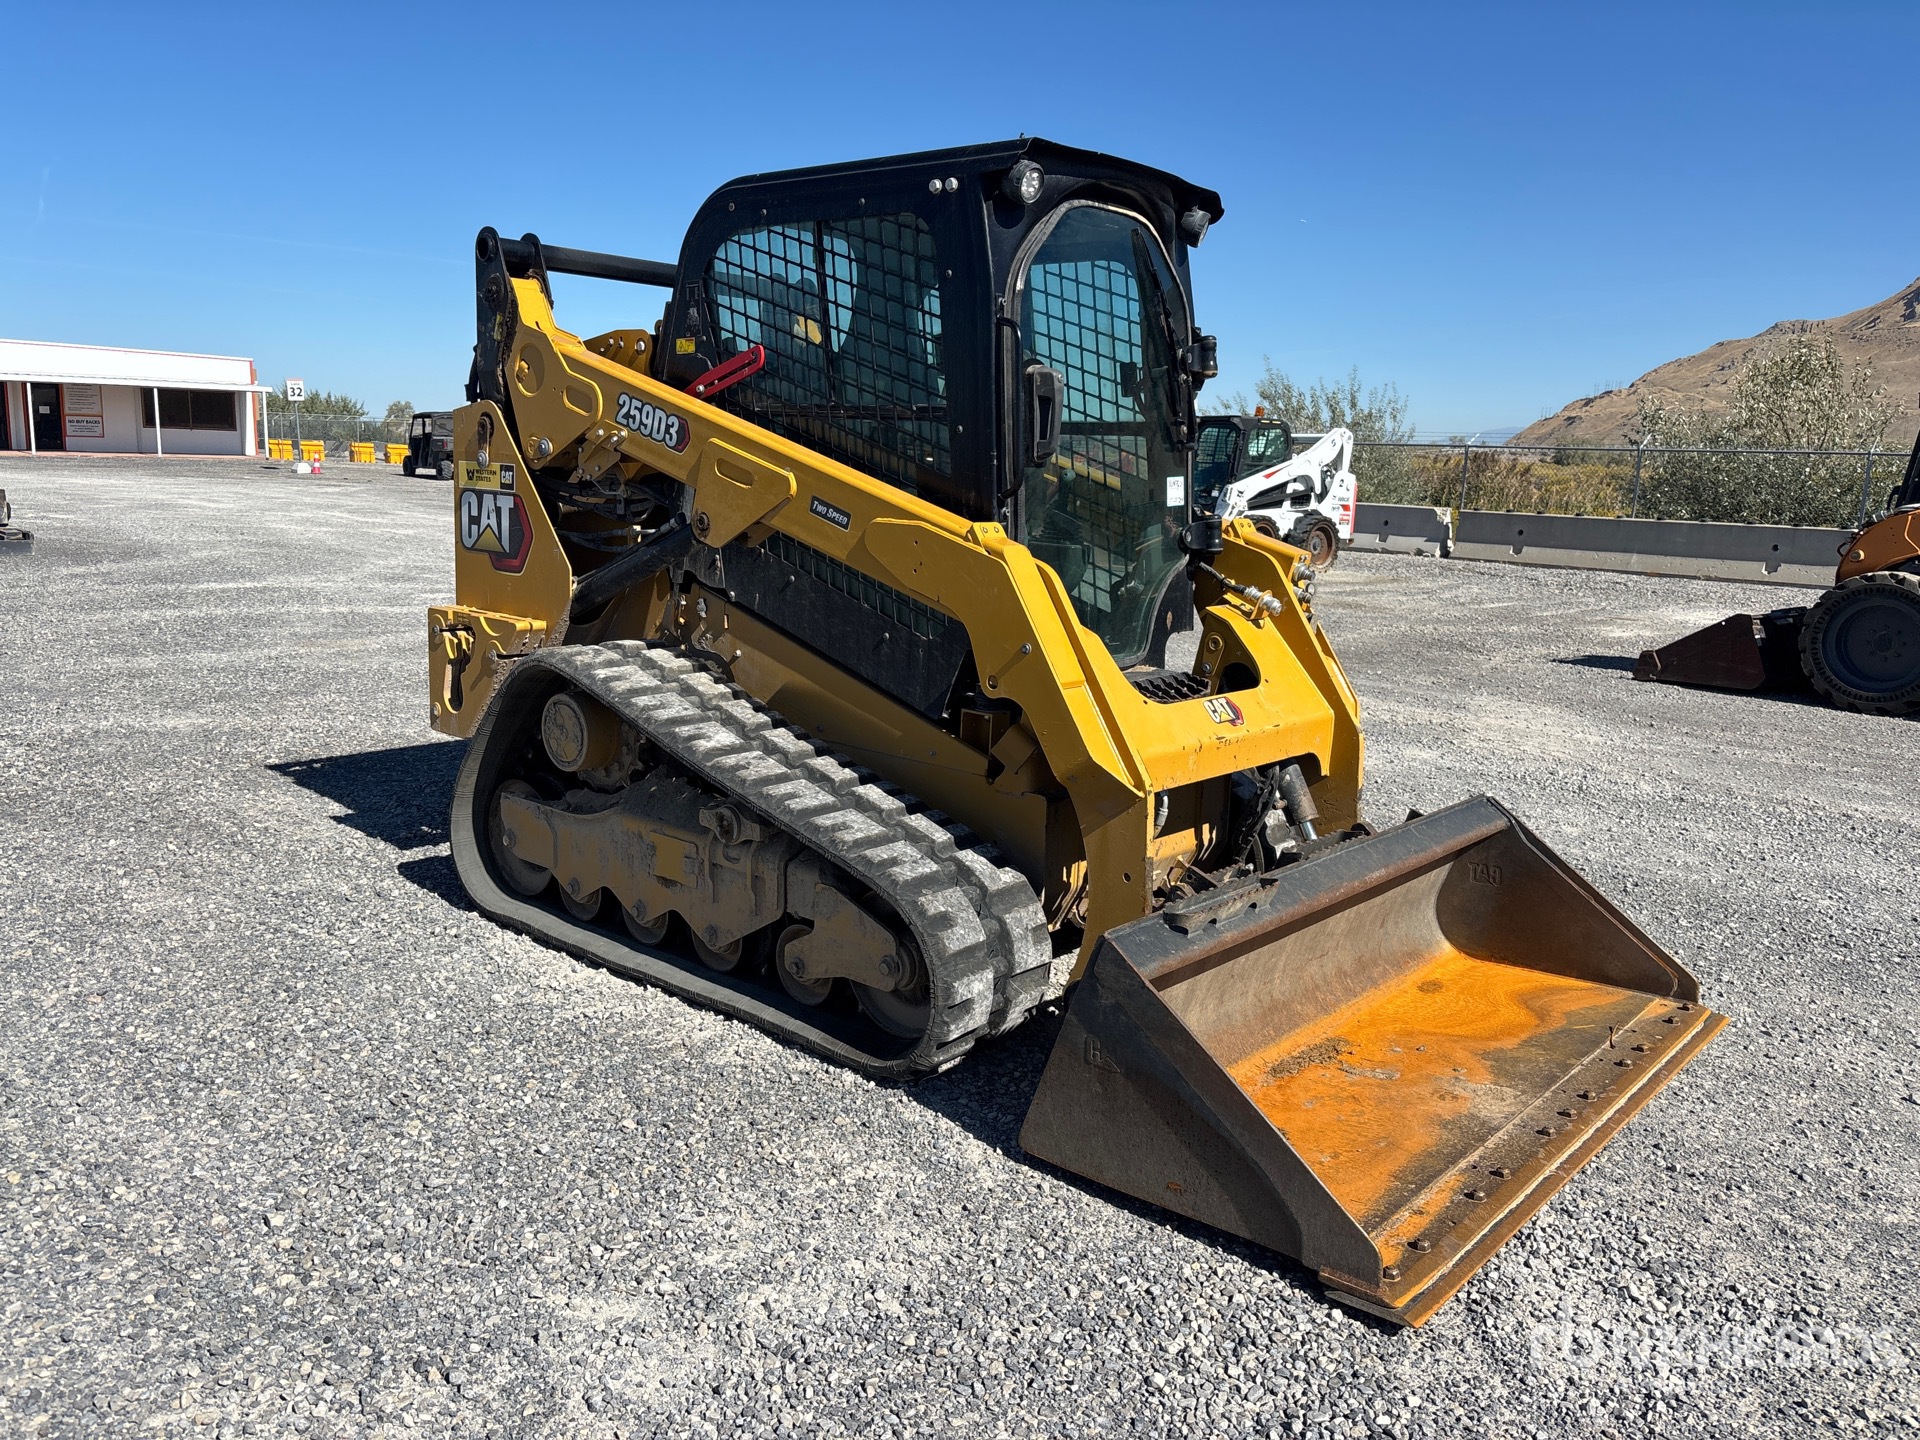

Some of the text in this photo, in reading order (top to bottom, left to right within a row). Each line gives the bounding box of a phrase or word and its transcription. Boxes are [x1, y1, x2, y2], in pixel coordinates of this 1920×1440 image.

[289, 387, 303, 397] 32
[616, 393, 679, 447] 259D3
[475, 468, 497, 476] WESTERN
[475, 475, 492, 483] STATES
[501, 470, 513, 484] CAT
[461, 490, 515, 554] CAT
[1203, 697, 1236, 723] CAT
